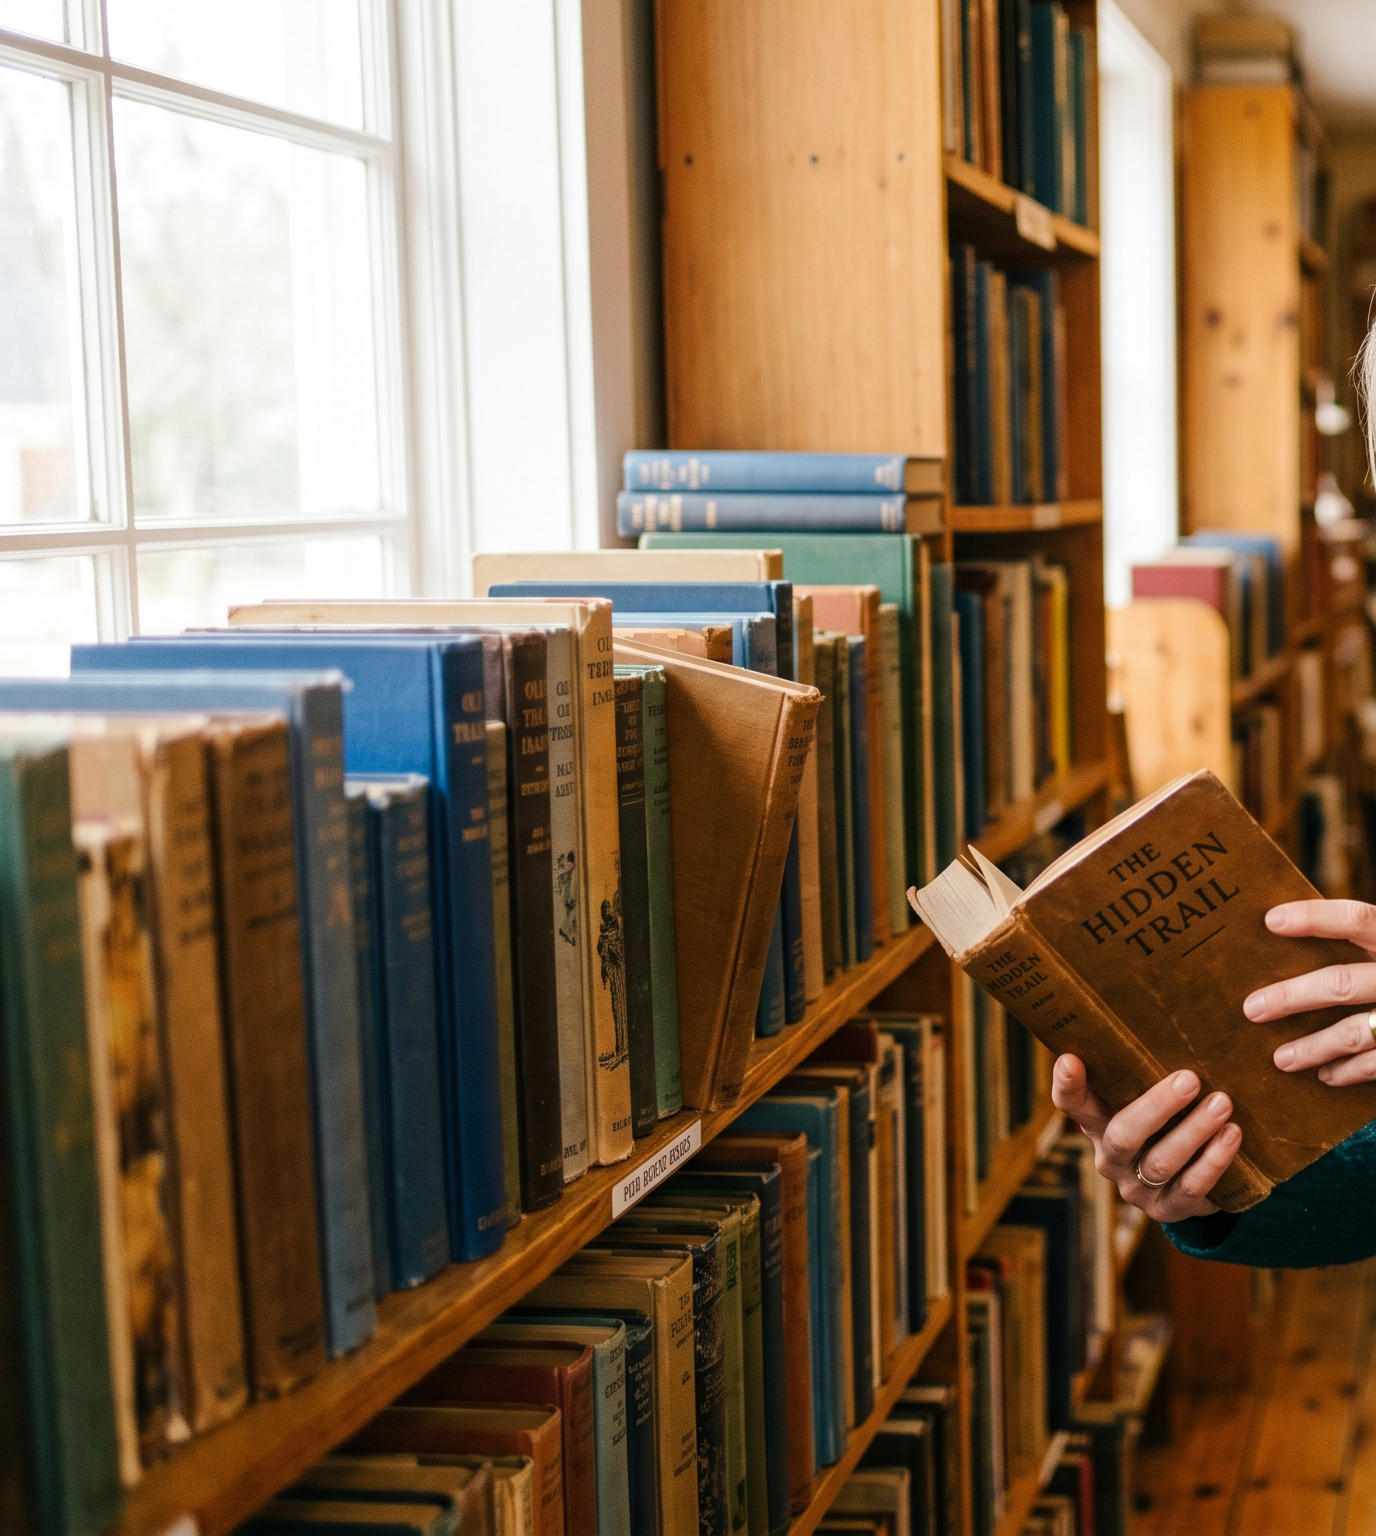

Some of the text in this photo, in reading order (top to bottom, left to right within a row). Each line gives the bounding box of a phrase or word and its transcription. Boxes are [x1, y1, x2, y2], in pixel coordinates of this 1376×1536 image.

[1107, 842, 1162, 883] THE
[1081, 831, 1229, 945] HIDDEN
[1125, 878, 1241, 956] TRAIL
[986, 951, 1018, 973] THE
[1005, 972, 1049, 1000] TRAIL
